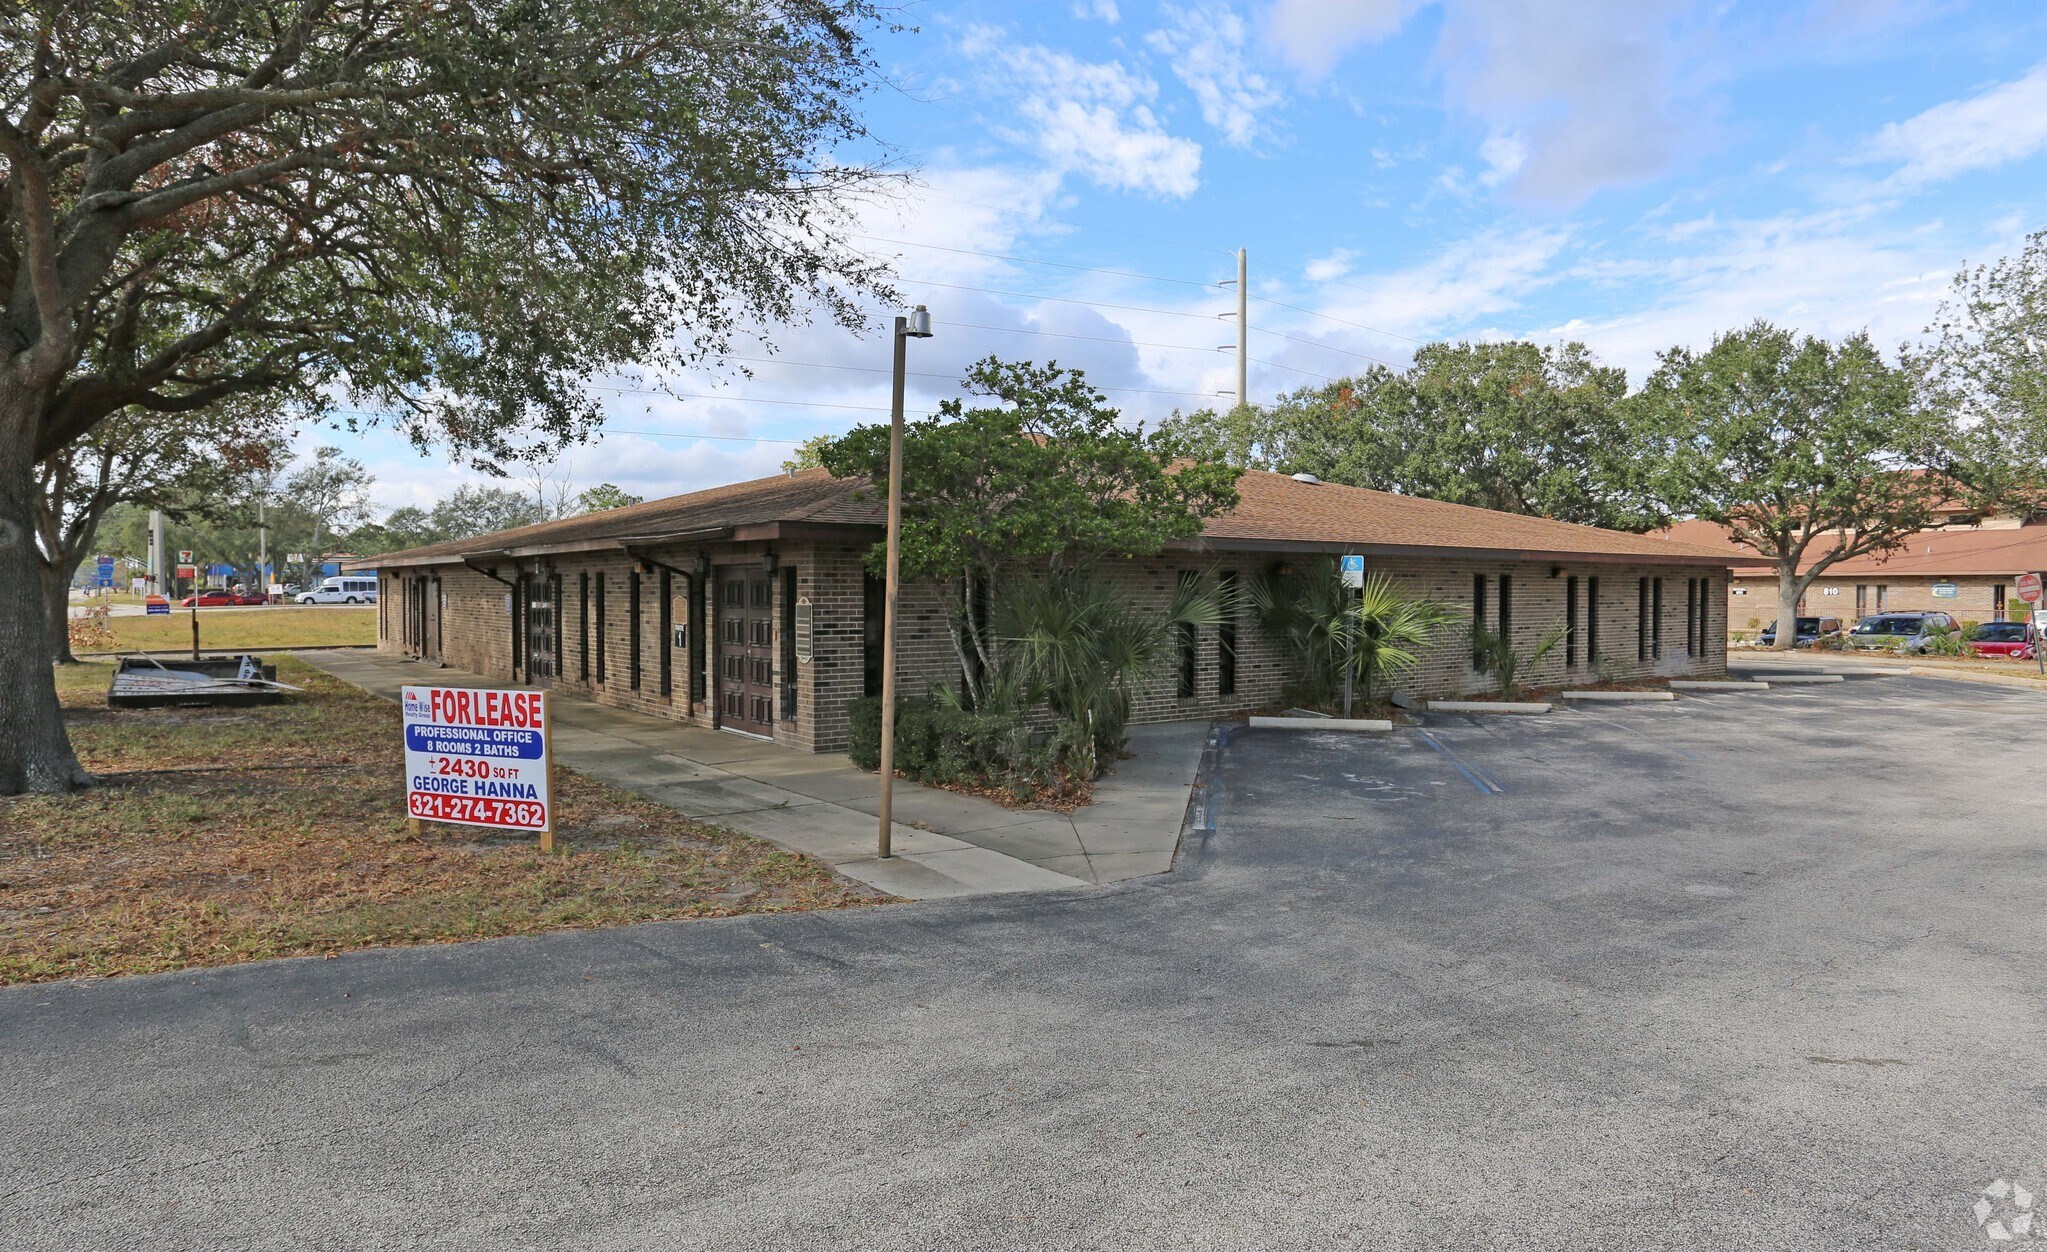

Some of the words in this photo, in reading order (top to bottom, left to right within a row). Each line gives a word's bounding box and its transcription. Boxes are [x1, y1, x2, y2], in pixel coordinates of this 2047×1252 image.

[1824, 588, 1838, 596] 810
[405, 701, 418, 712] Home
[419, 702, 430, 712] Wise
[431, 690, 472, 724] FOR
[473, 692, 542, 728] LEASE
[414, 726, 491, 741] PROFESSIONAL
[493, 731, 533, 743] OFFICE
[427, 740, 434, 751] 8
[435, 741, 472, 754] ROOMS
[474, 745, 482, 755] 2
[483, 744, 520, 757] BATHS
[438, 757, 490, 779] 2430
[493, 767, 506, 779] SQ
[507, 768, 520, 780] FT
[413, 775, 469, 795] GEORGE
[474, 781, 538, 800] HANNA
[412, 795, 542, 826] 321-274-7362
